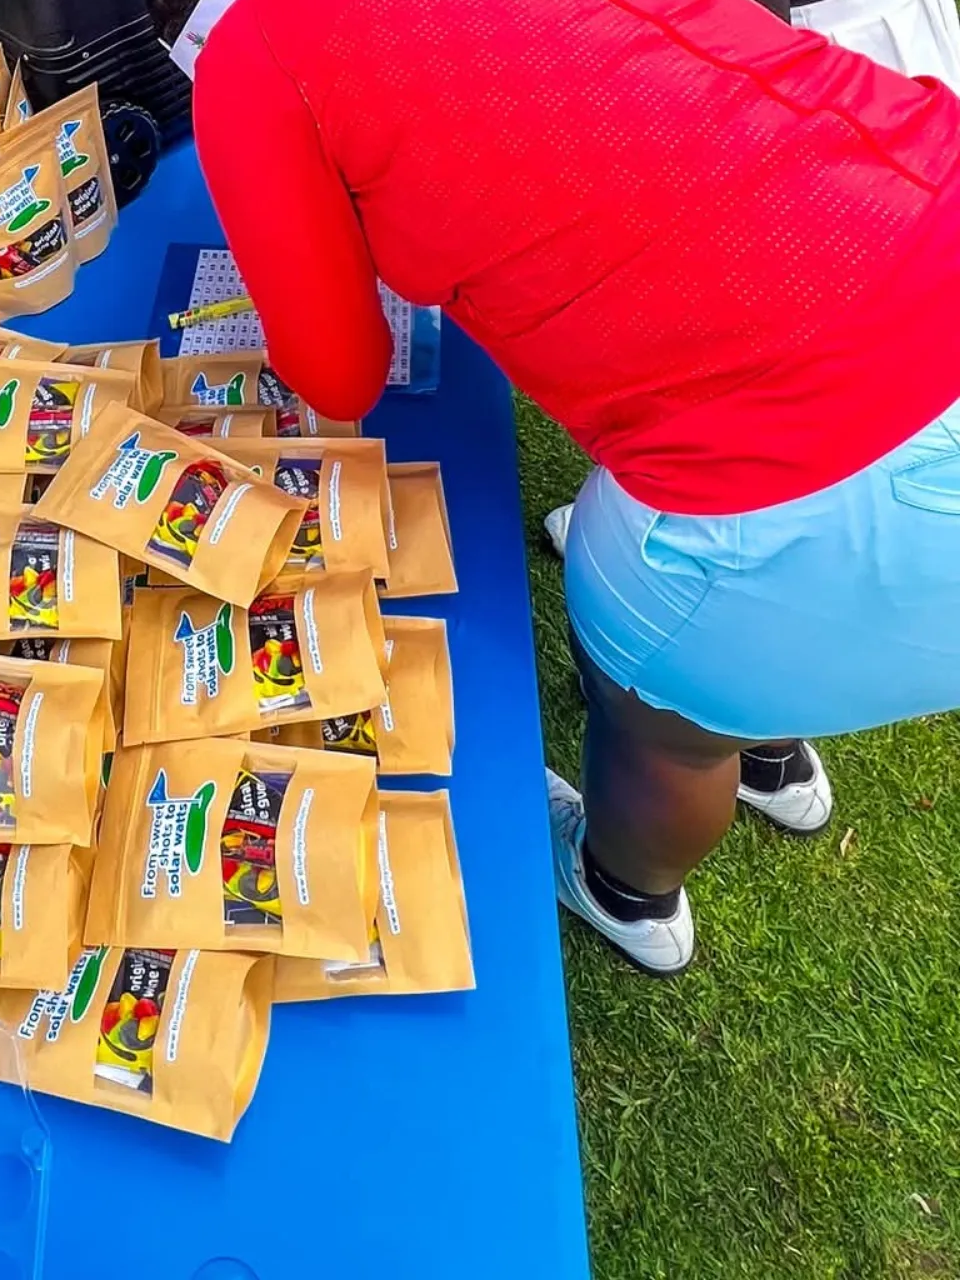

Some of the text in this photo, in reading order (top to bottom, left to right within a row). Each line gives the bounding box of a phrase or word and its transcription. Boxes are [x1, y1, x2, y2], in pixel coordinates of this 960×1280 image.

[197, 633, 205, 648] to
[183, 672, 195, 703] From
[207, 664, 217, 696] solar
[143, 805, 165, 895] From sweet
[159, 803, 176, 867] shots to
[168, 803, 188, 894] solar watts
[20, 996, 44, 1037] From
[46, 999, 67, 1040] solar
